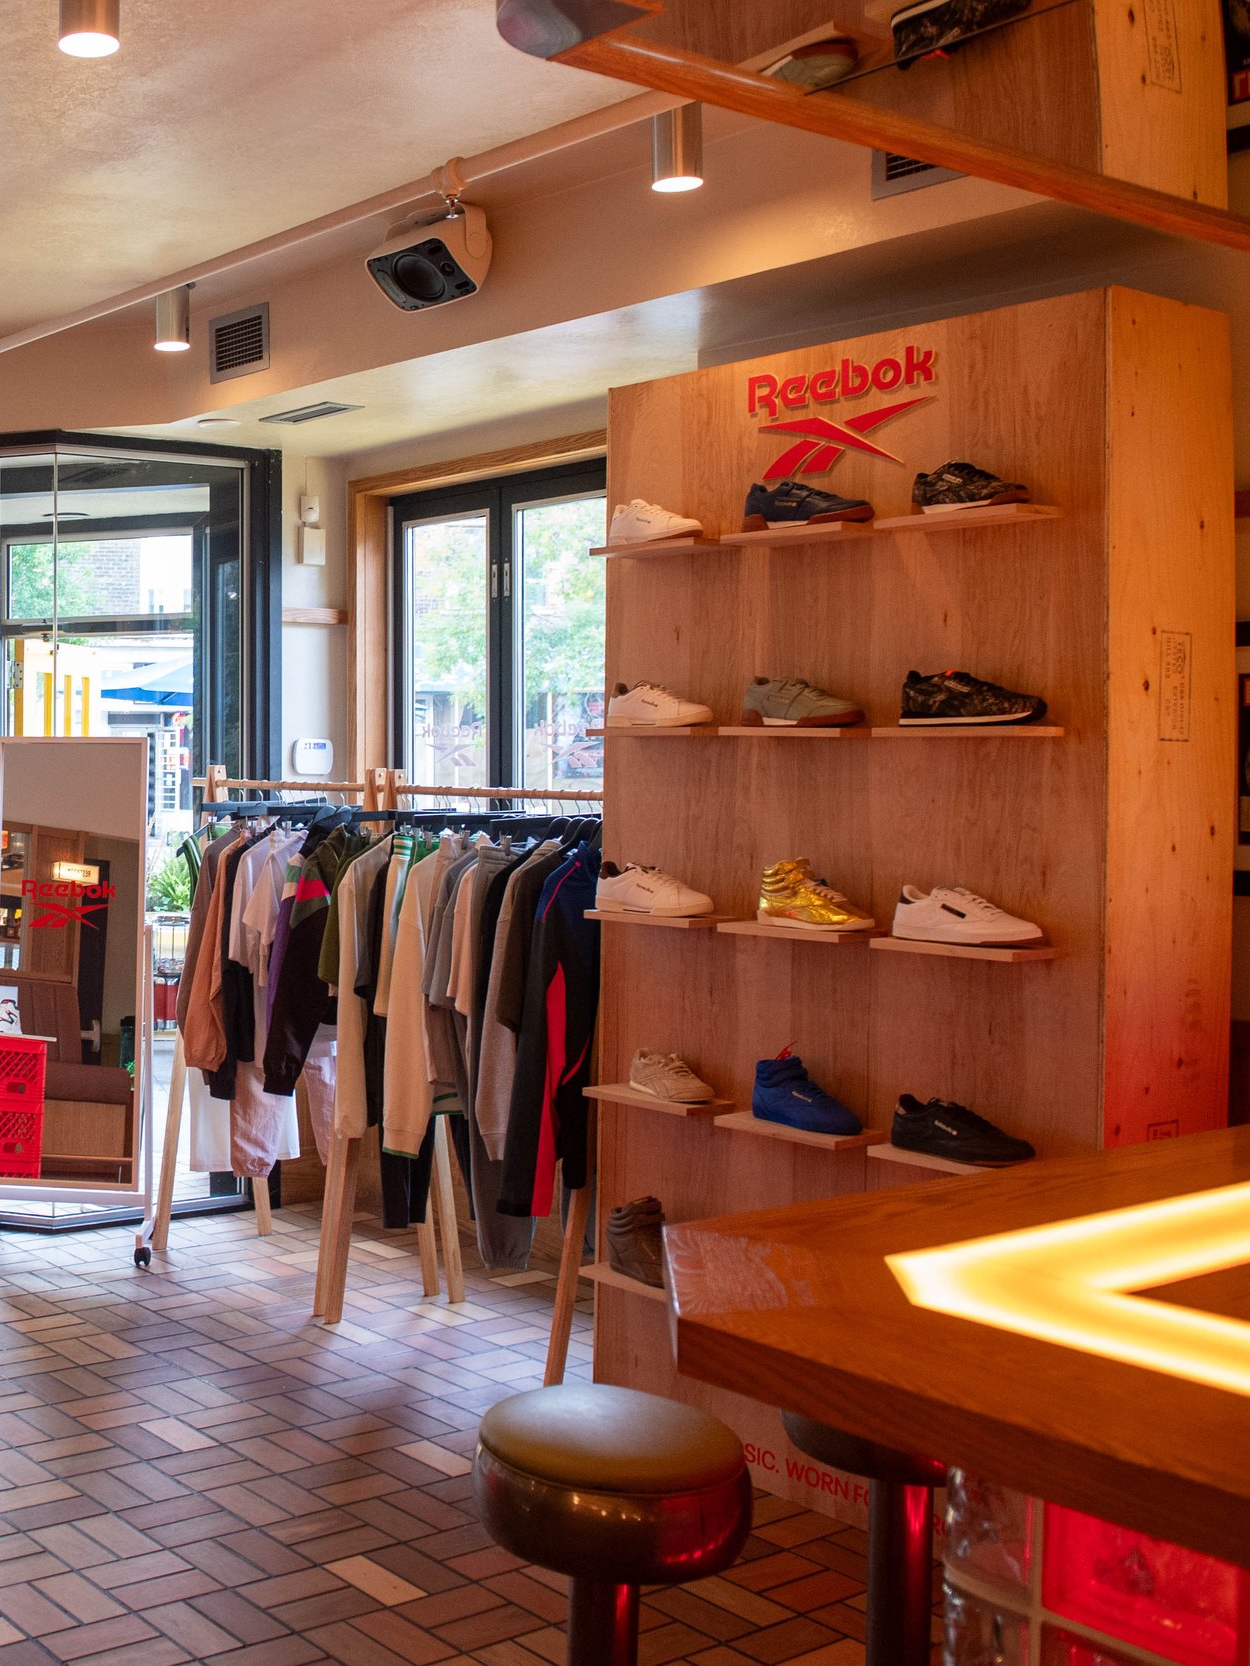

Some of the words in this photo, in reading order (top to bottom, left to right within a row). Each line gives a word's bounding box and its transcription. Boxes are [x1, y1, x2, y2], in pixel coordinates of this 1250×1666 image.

[748, 345, 934, 418] Reebok
[21, 879, 118, 901] Reebok
[785, 1457, 850, 1501] WORN
